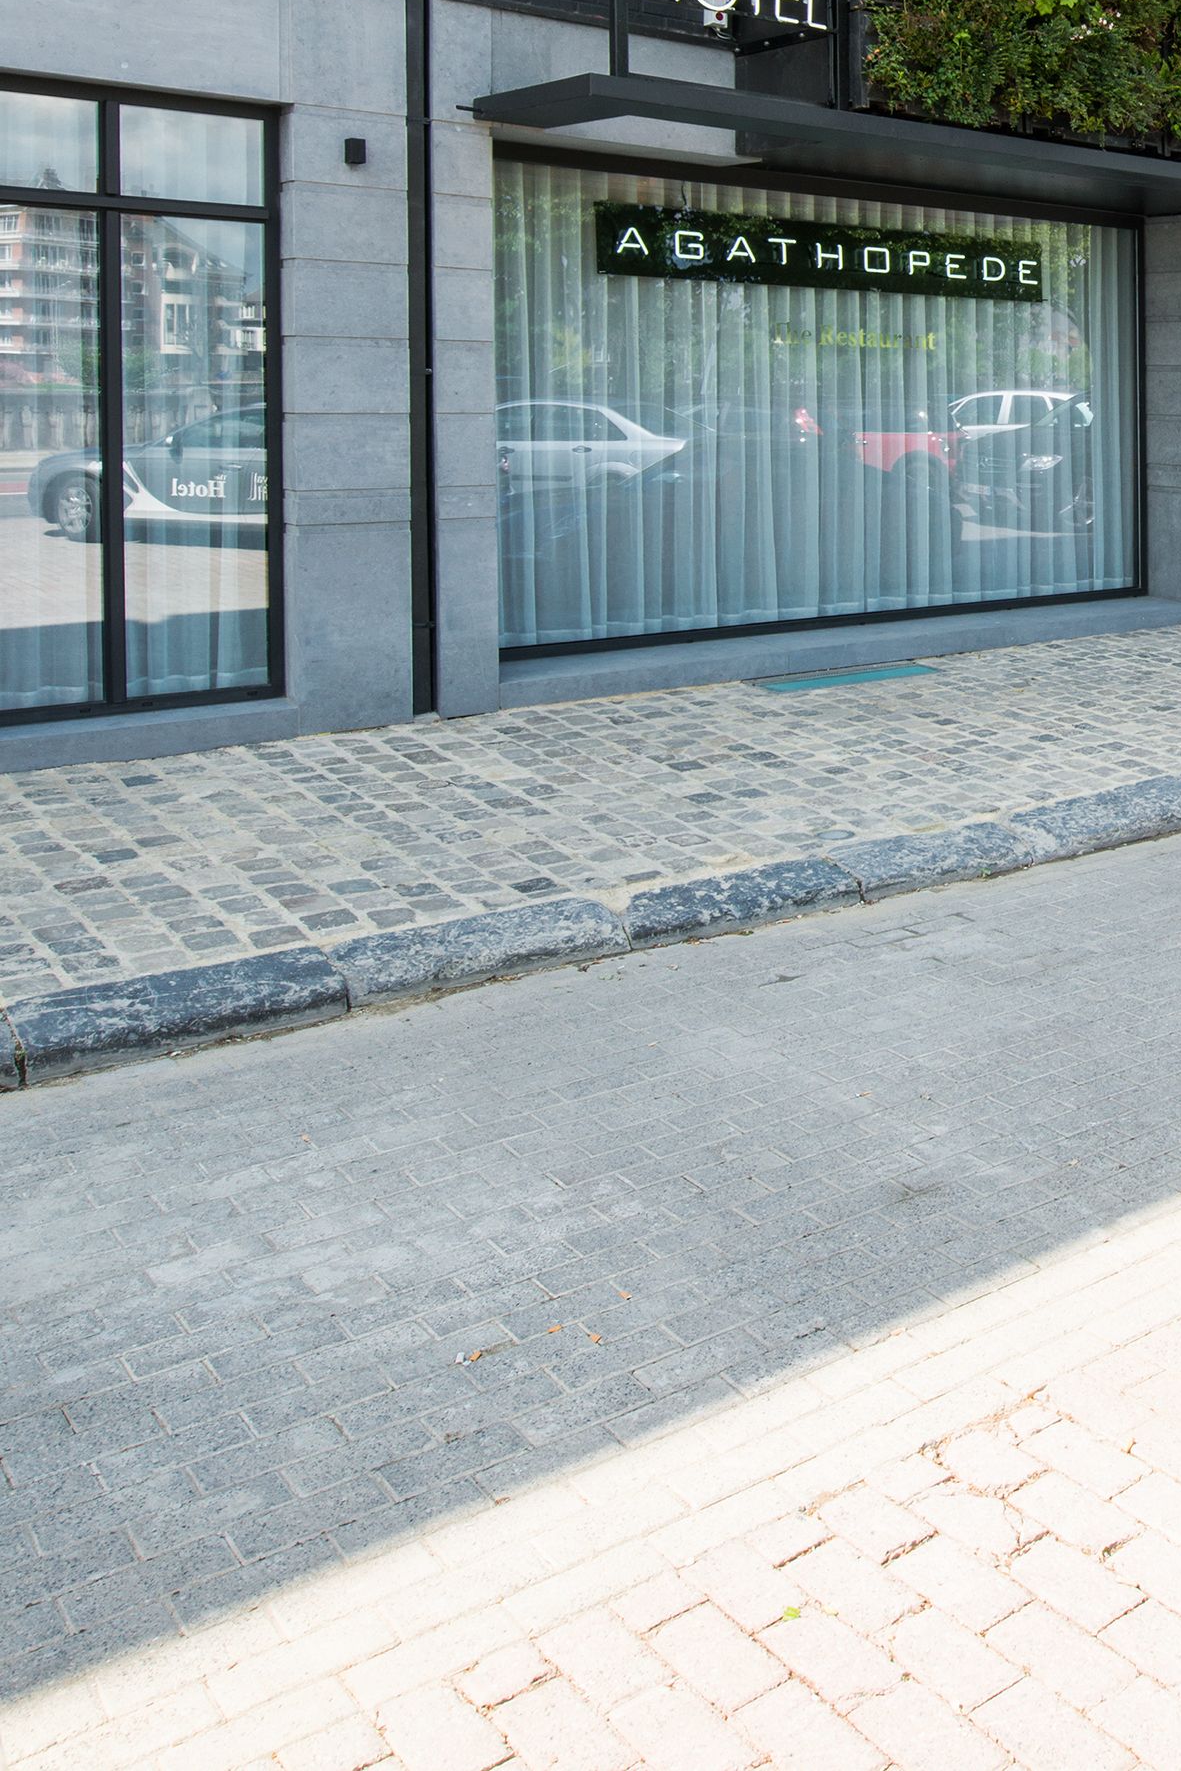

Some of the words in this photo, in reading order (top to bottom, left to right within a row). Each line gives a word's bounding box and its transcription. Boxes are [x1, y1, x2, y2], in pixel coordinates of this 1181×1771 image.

[616, 227, 1039, 285] AGATHOPEDE
[773, 321, 812, 345] The
[819, 324, 937, 350] Restaurant
